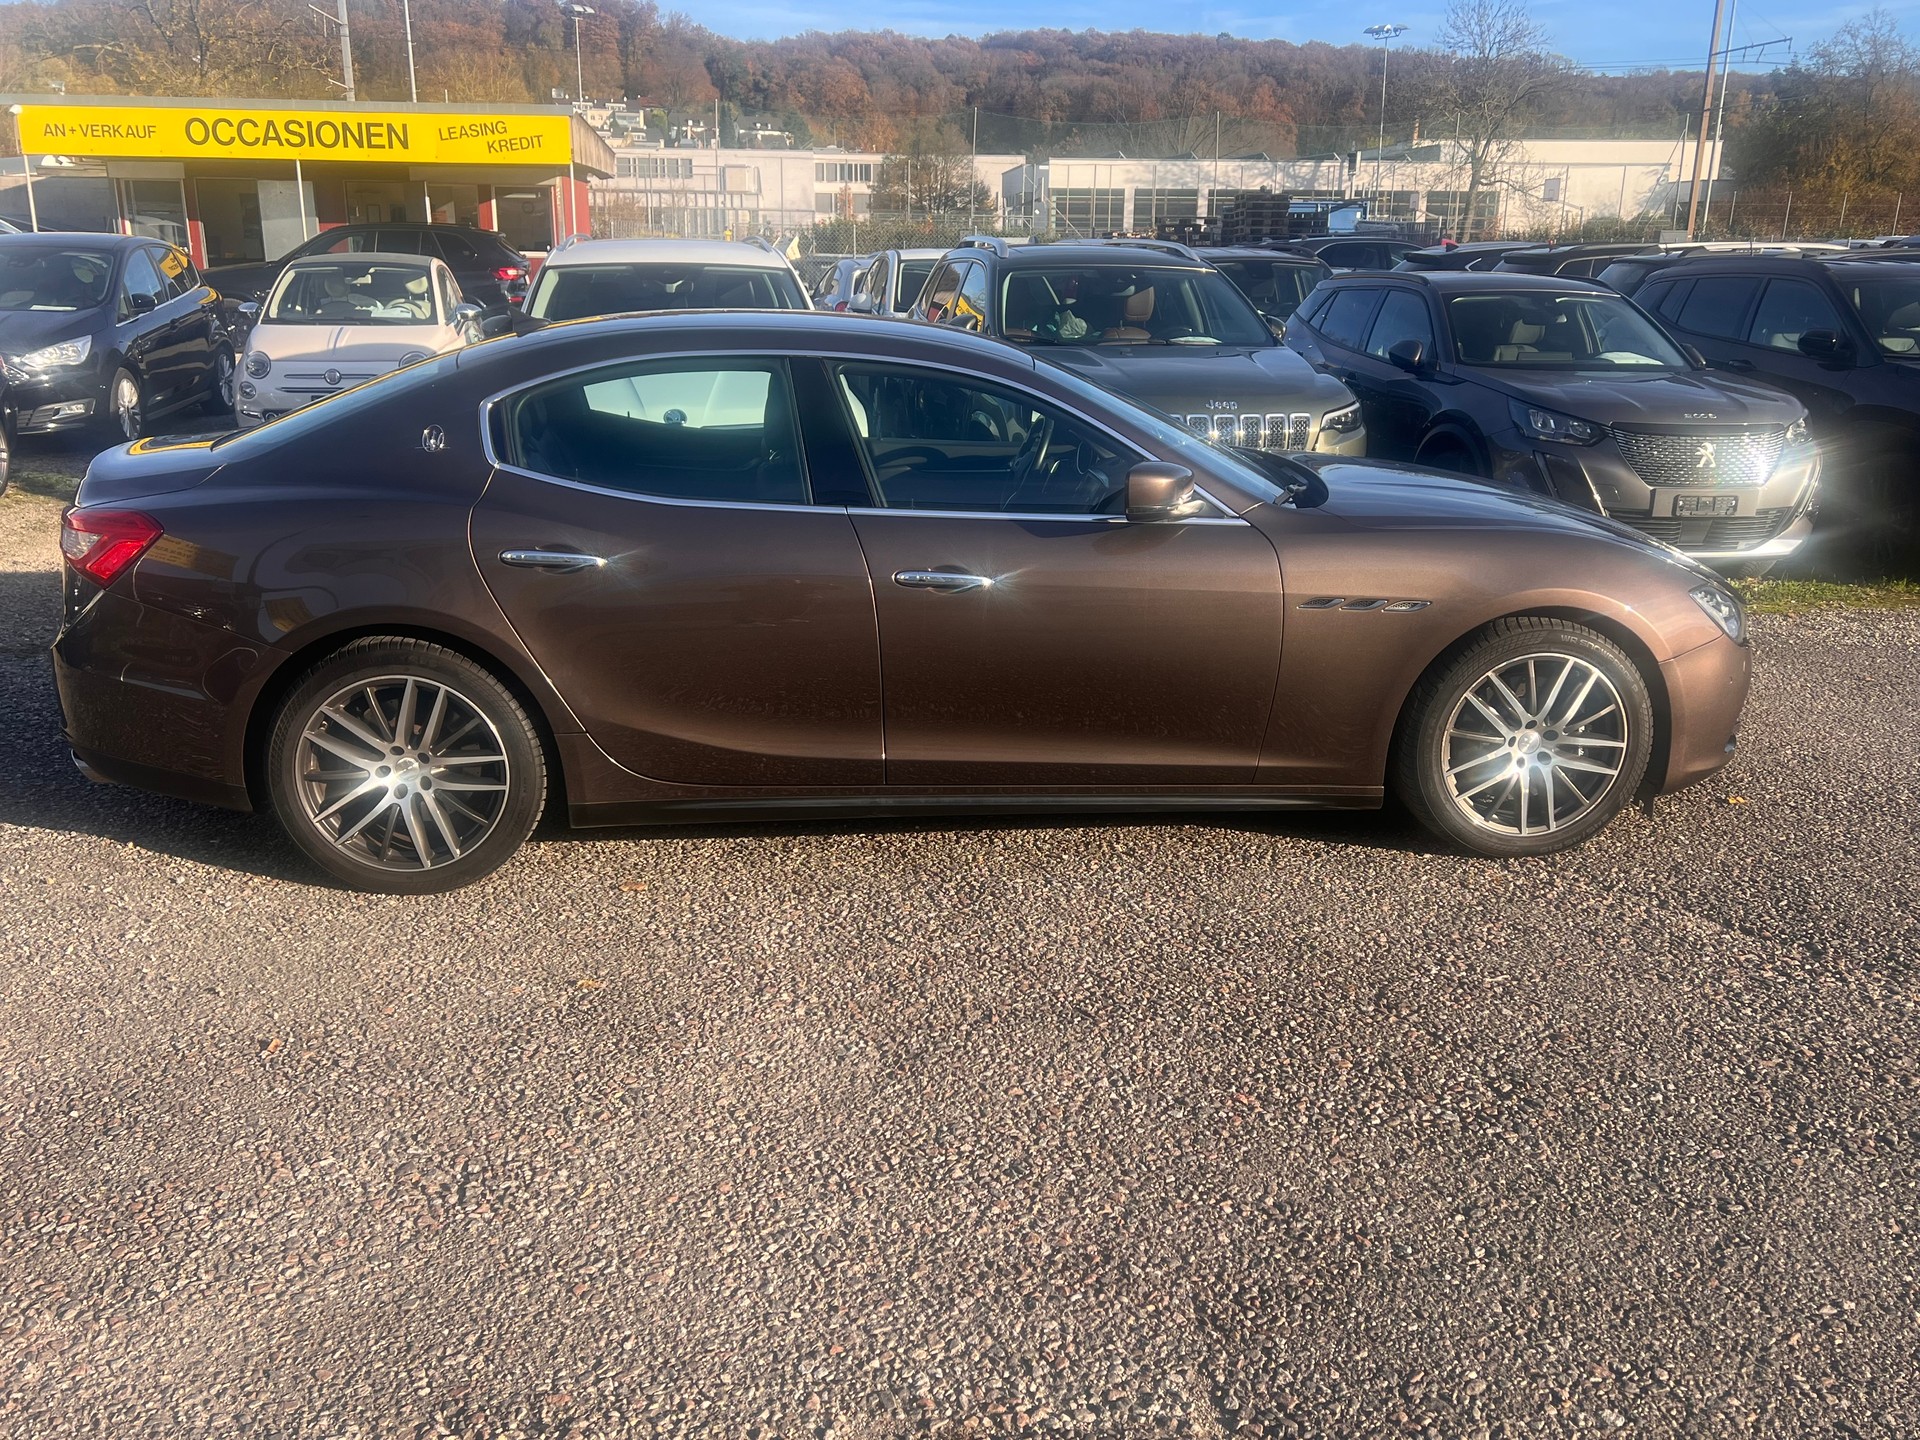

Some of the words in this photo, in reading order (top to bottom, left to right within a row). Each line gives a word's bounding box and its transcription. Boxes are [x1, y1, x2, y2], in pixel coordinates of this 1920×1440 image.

[43, 123, 66, 137] AN
[79, 123, 157, 139] VERKAUF
[185, 117, 409, 150] OCCASIONEN
[438, 120, 508, 141] LEASING
[487, 135, 544, 154] KREDIT
[1205, 399, 1238, 411] Jeep
